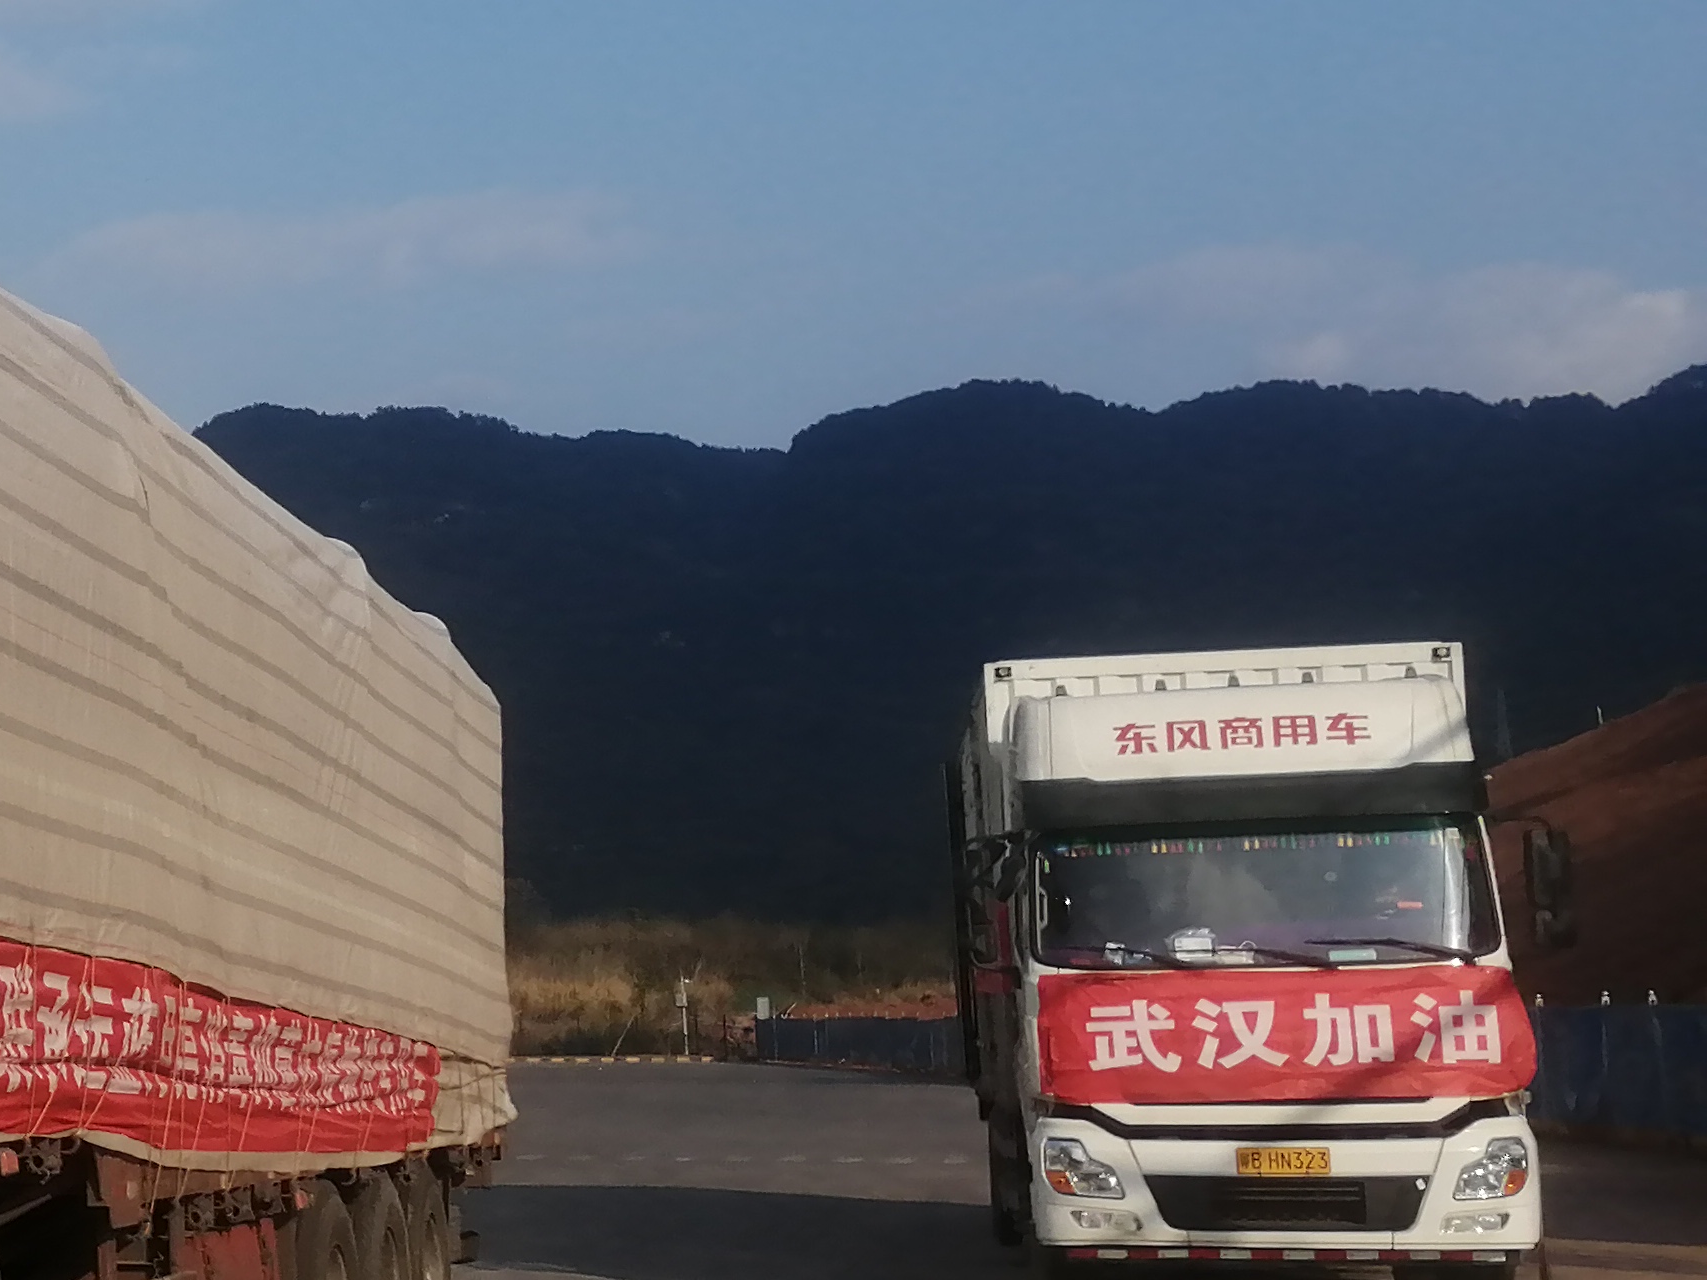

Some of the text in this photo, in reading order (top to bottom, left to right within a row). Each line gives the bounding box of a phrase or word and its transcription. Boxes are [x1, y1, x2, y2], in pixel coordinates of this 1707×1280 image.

[1112, 712, 1373, 757] 东风商用车
[1086, 990, 1502, 1074] 武汉加油
